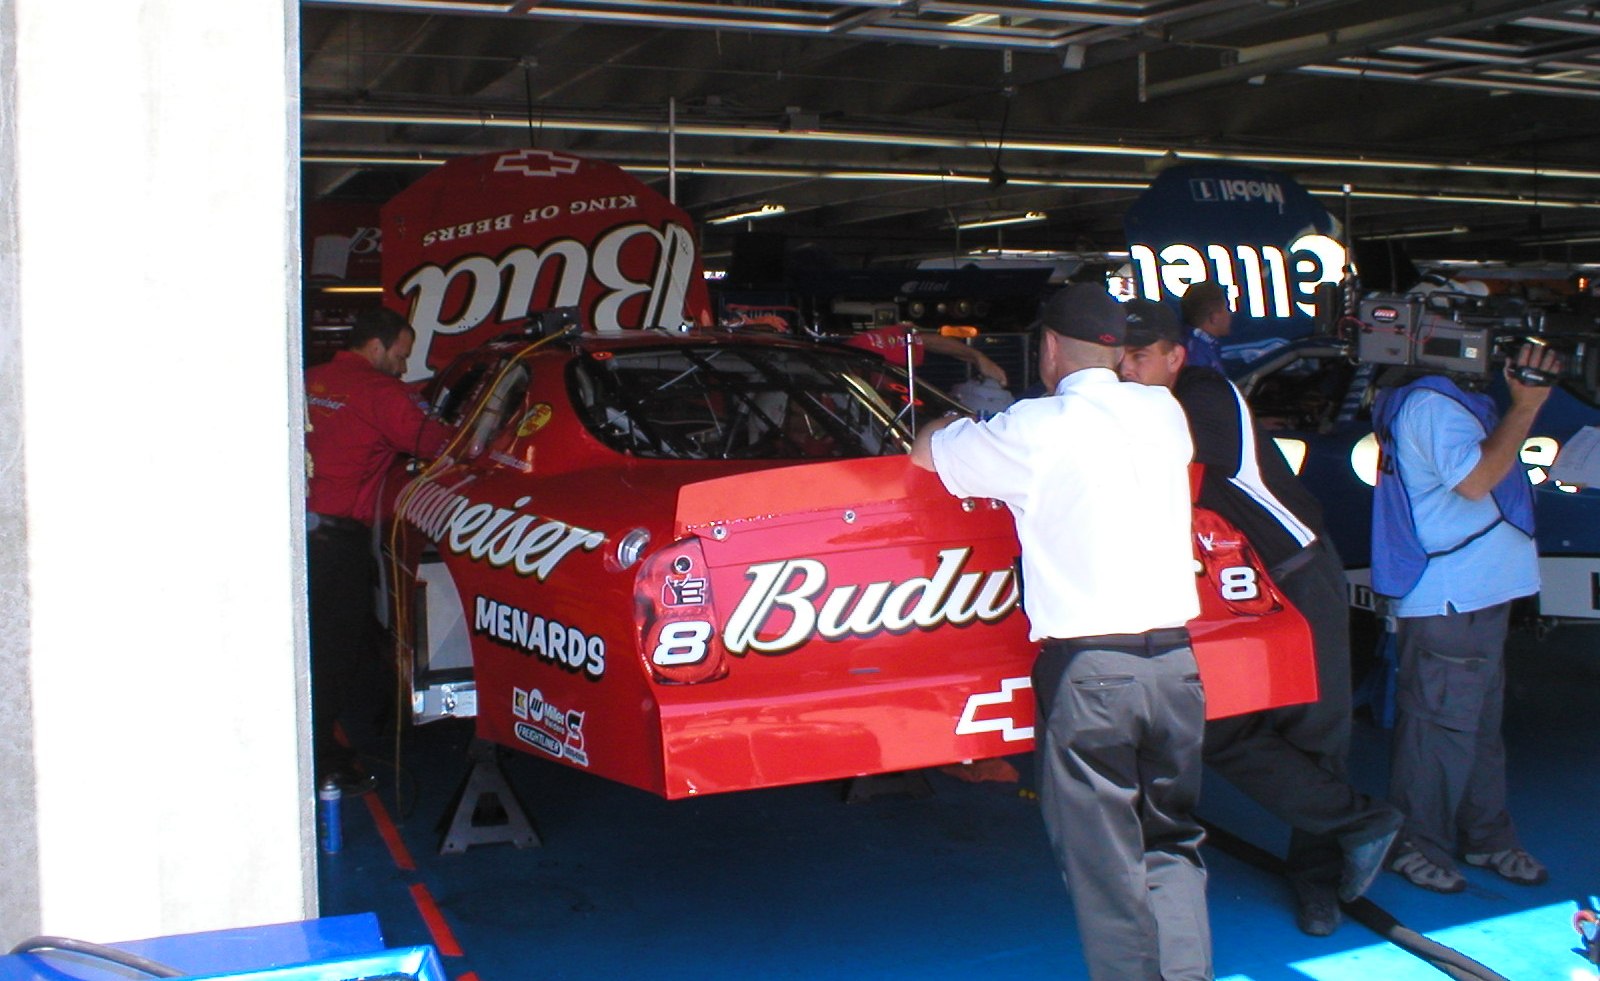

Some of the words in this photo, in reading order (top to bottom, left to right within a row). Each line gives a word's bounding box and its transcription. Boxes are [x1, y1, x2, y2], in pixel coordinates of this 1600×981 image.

[571, 194, 638, 217] KING
[1219, 178, 1284, 206] Mobil
[422, 214, 512, 247] BEERS
[523, 204, 560, 226] OF
[401, 222, 697, 383] Bud
[1219, 566, 1260, 601] 8
[721, 547, 1019, 656] Budw
[474, 594, 606, 681] MENARDS
[652, 620, 714, 667] 8
